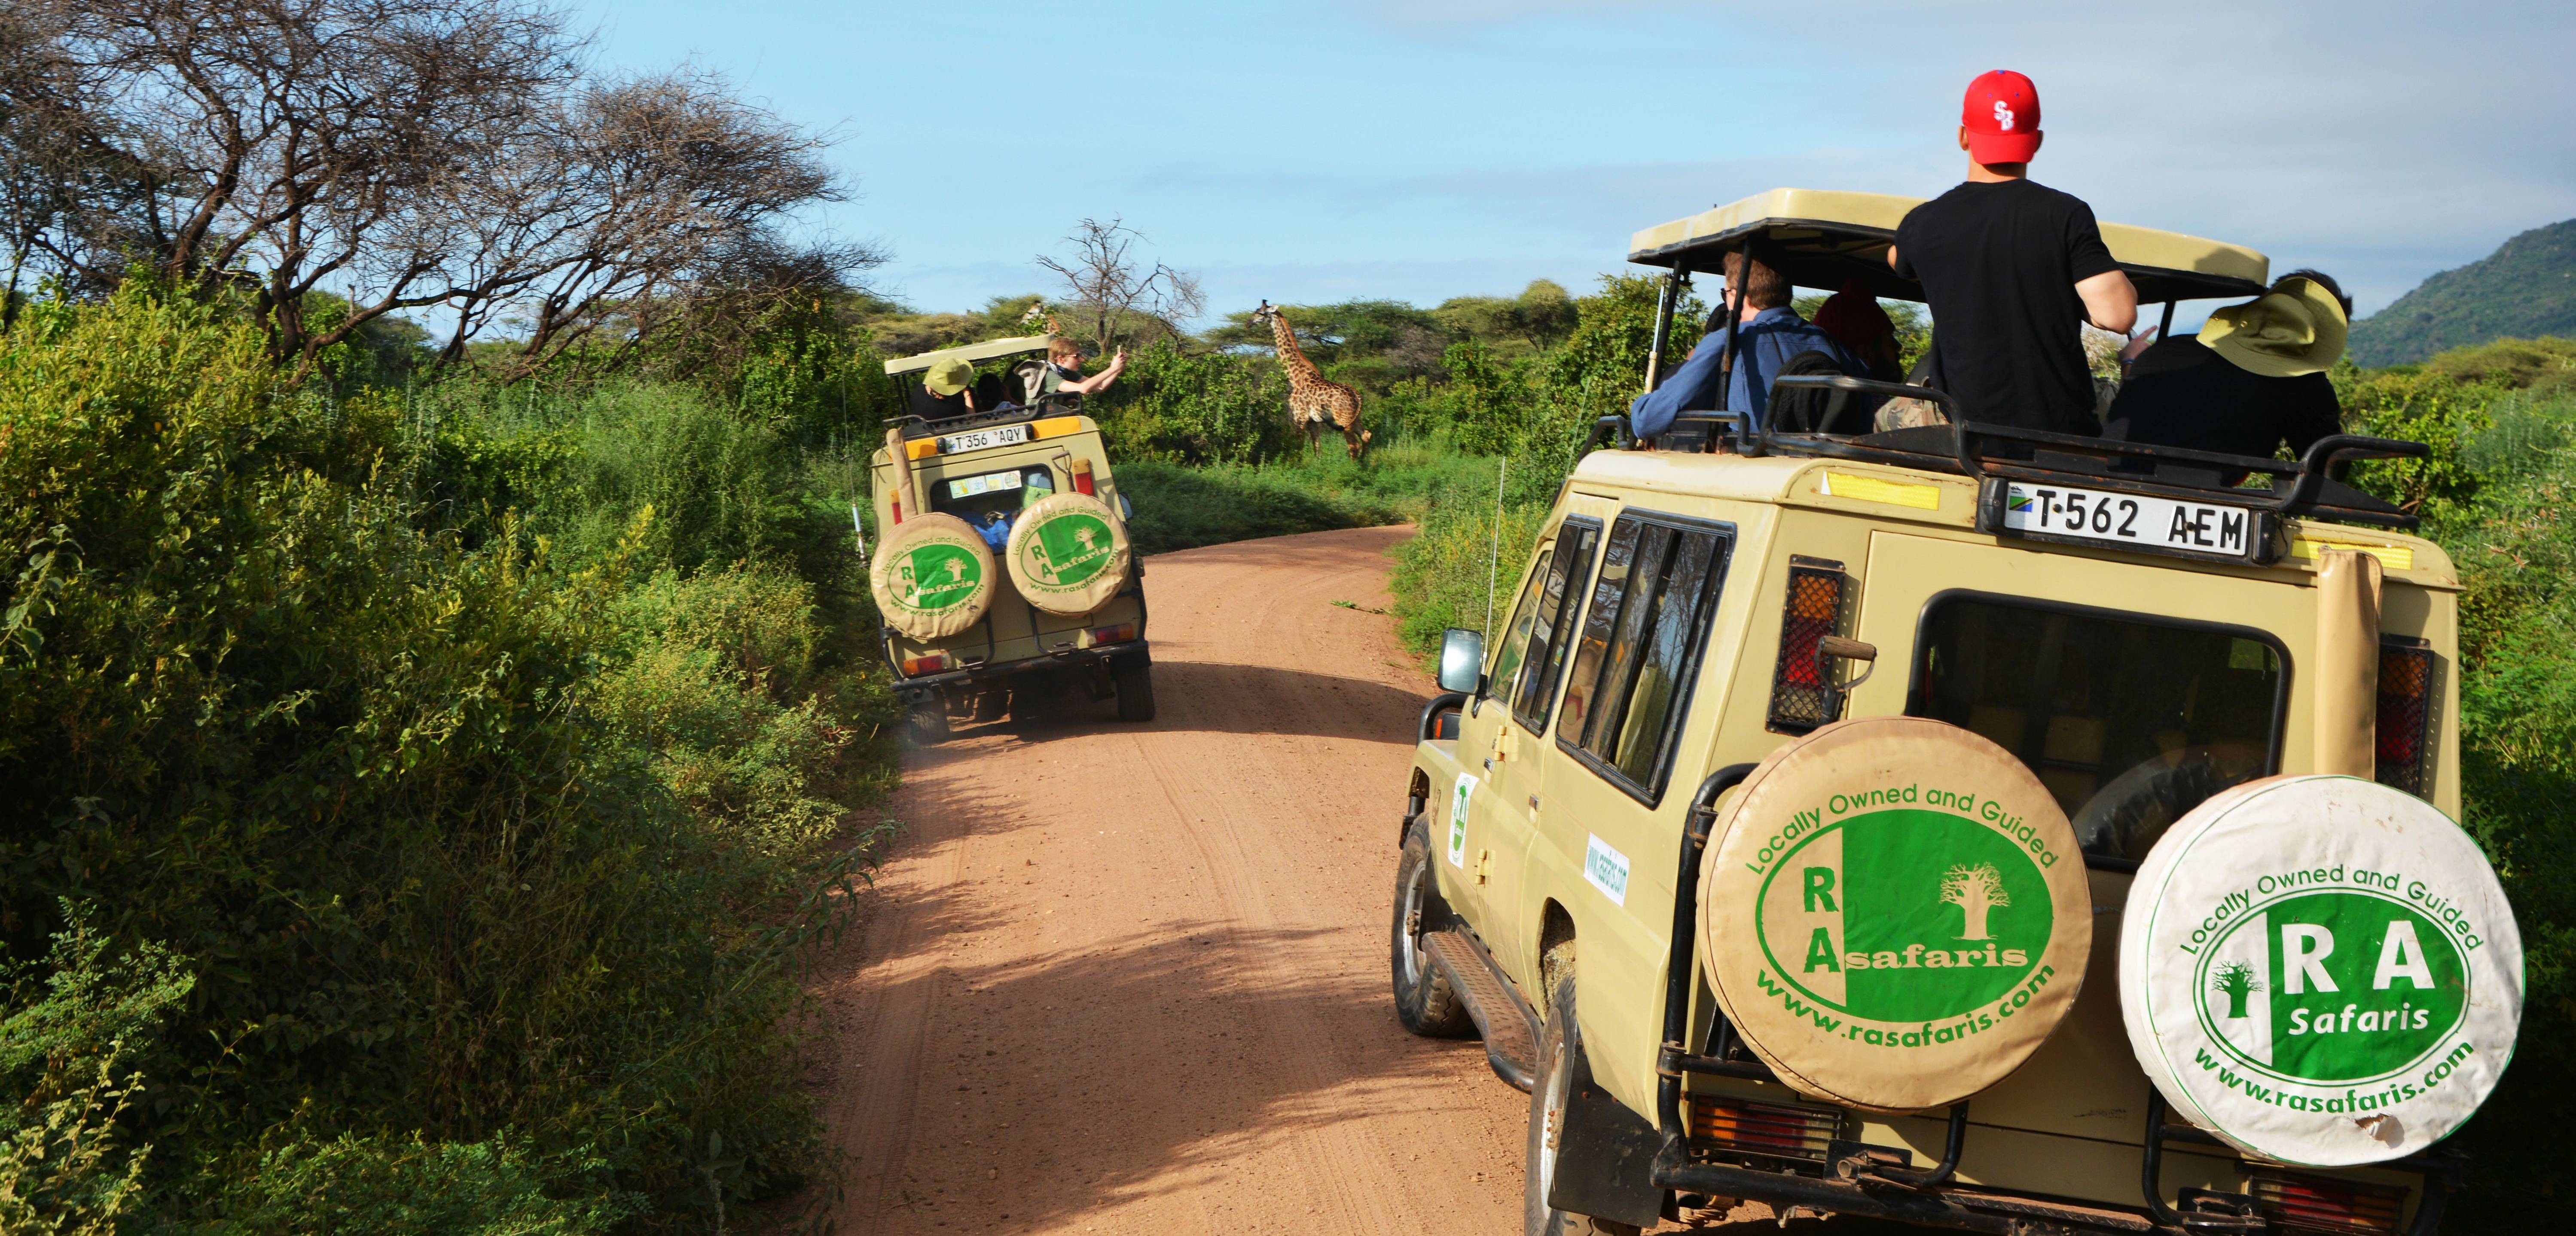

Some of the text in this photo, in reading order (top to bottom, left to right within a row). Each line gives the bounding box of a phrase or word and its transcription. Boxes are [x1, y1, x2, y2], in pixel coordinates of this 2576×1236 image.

[1000, 428, 1020, 443] AQY
[1013, 506, 1108, 556] Locally Owned and Guided
[2168, 506, 2243, 550] AEM
[882, 549, 904, 572] Locally
[905, 537, 933, 551] Owned
[954, 538, 981, 556] Guided
[1030, 548, 1120, 594] www.rasafaris.com
[891, 584, 985, 617] www.rasafaris.com
[1746, 783, 2059, 875] Locally Owned and Guided
[2180, 864, 2484, 955] Locally Owned and Guided
[1757, 964, 2055, 1048] www.rasafaris.com
[2289, 1003, 2429, 1035] Safaris
[2195, 1041, 2474, 1114] www.rasafaris.com
